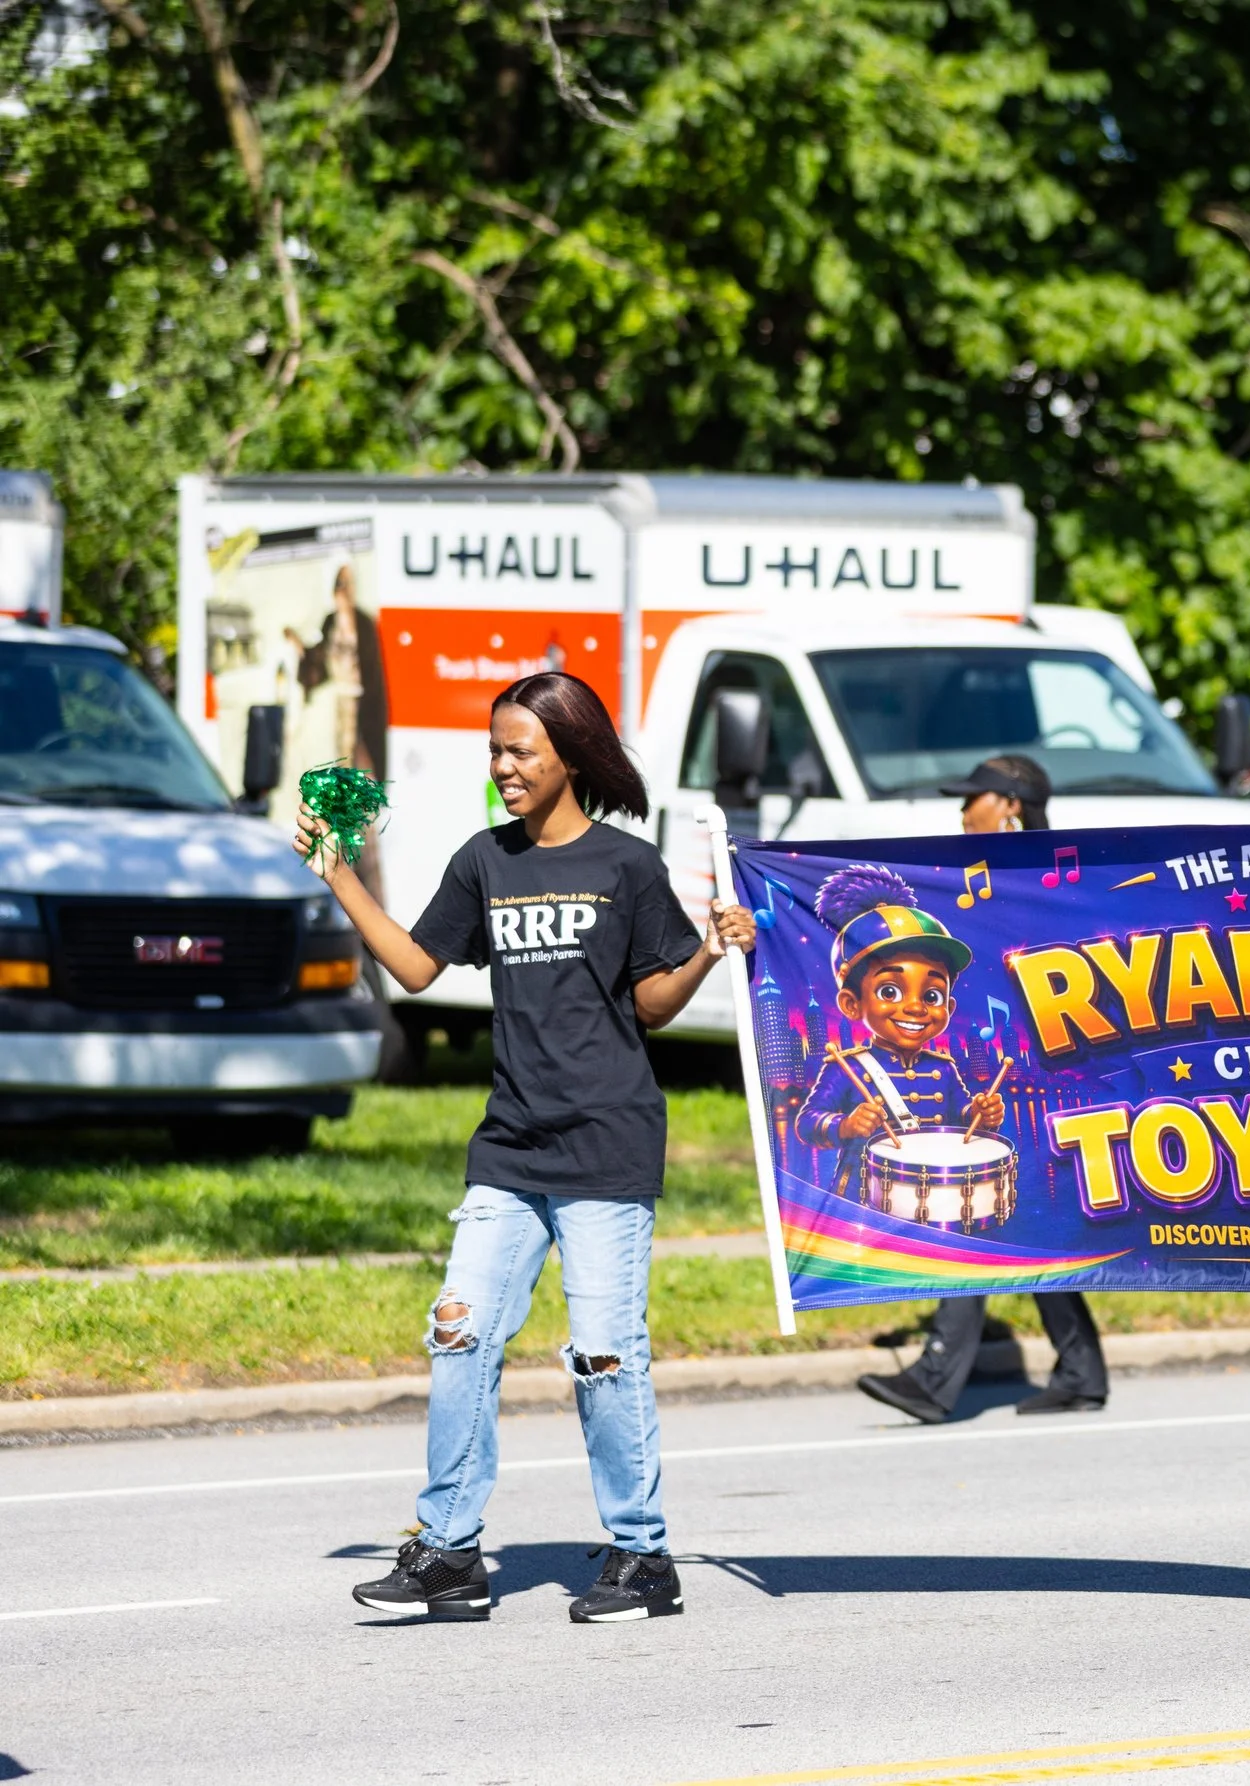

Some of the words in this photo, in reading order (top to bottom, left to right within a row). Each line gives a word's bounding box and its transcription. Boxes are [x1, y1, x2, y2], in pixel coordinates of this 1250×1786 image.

[1165, 848, 1233, 890] THE
[490, 897, 503, 907] The
[503, 895, 541, 905] Adventures
[541, 892, 550, 904] of
[549, 892, 570, 903] Ryan
[577, 893, 598, 903] Riley
[489, 904, 597, 951] RRP
[522, 952, 530, 963] &
[531, 950, 552, 963] Riley
